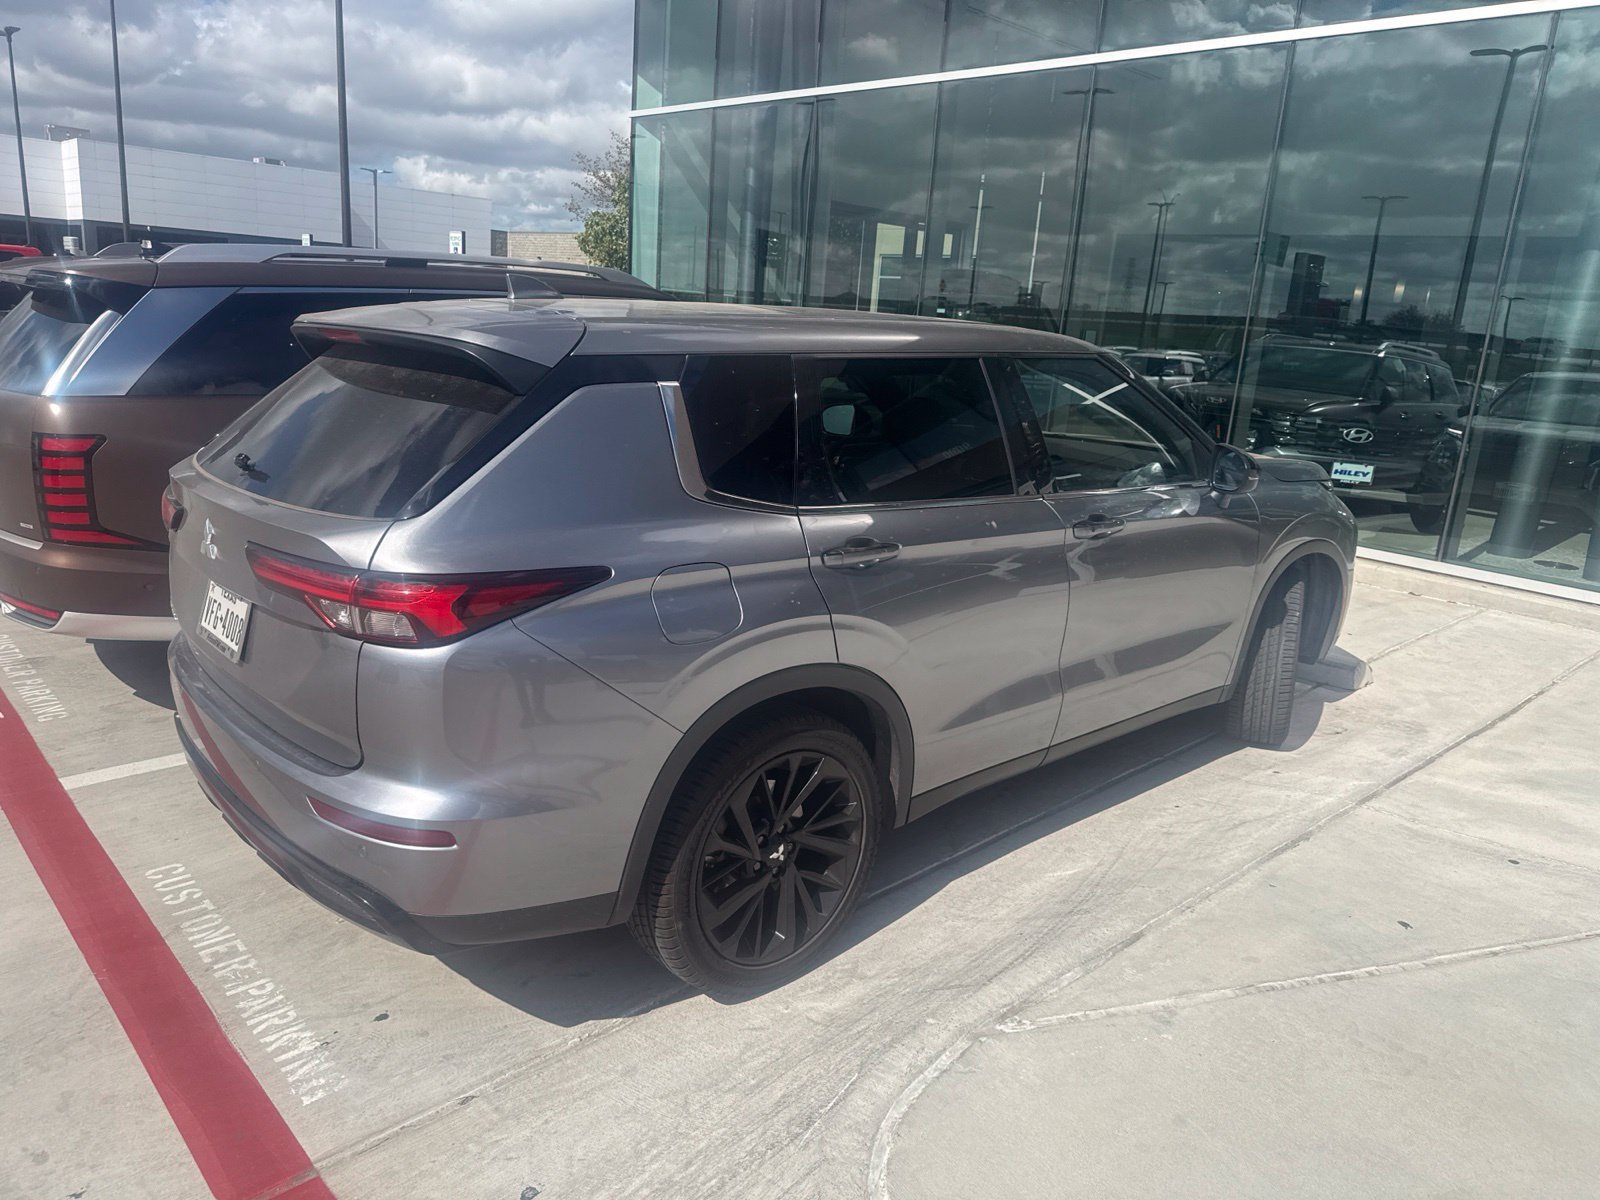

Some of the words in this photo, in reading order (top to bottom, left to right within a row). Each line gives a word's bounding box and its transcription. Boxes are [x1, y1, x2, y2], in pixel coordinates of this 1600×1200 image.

[1333, 469, 1370, 477] HILEY
[12, 678, 68, 722] PARKING
[145, 863, 262, 983] CUSTOMER
